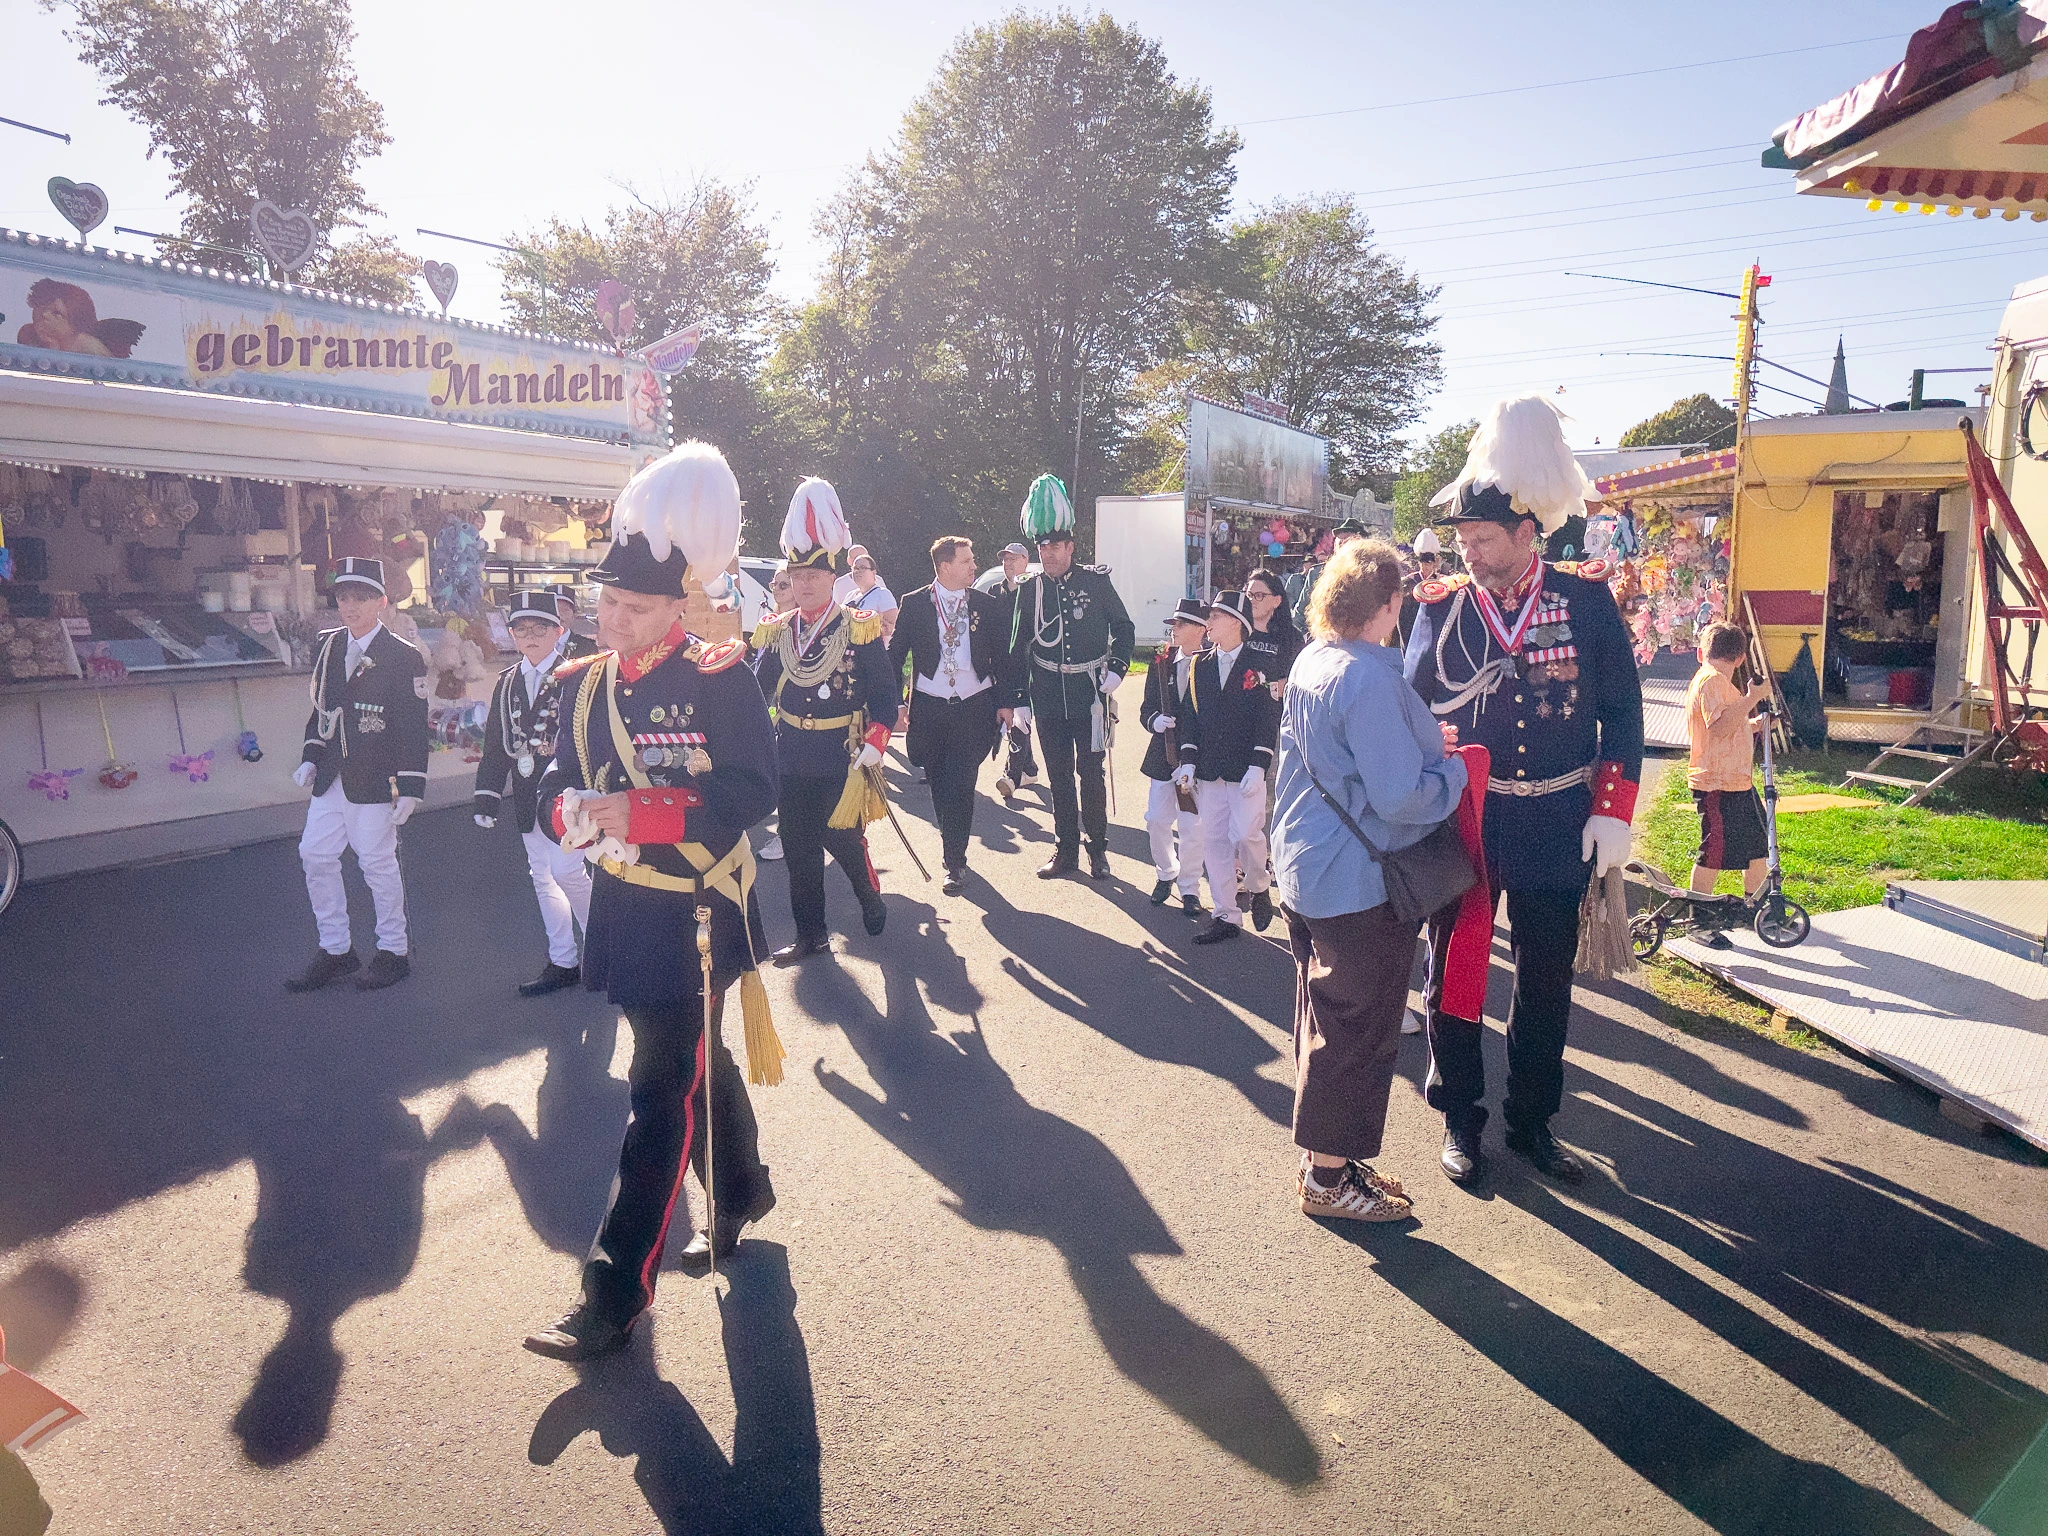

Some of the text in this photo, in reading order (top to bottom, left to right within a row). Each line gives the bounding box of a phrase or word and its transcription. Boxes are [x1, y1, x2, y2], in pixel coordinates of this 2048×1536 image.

[196, 324, 454, 372] gebrannte
[653, 342, 693, 371] Mandeln
[431, 363, 625, 406] Mandeln
